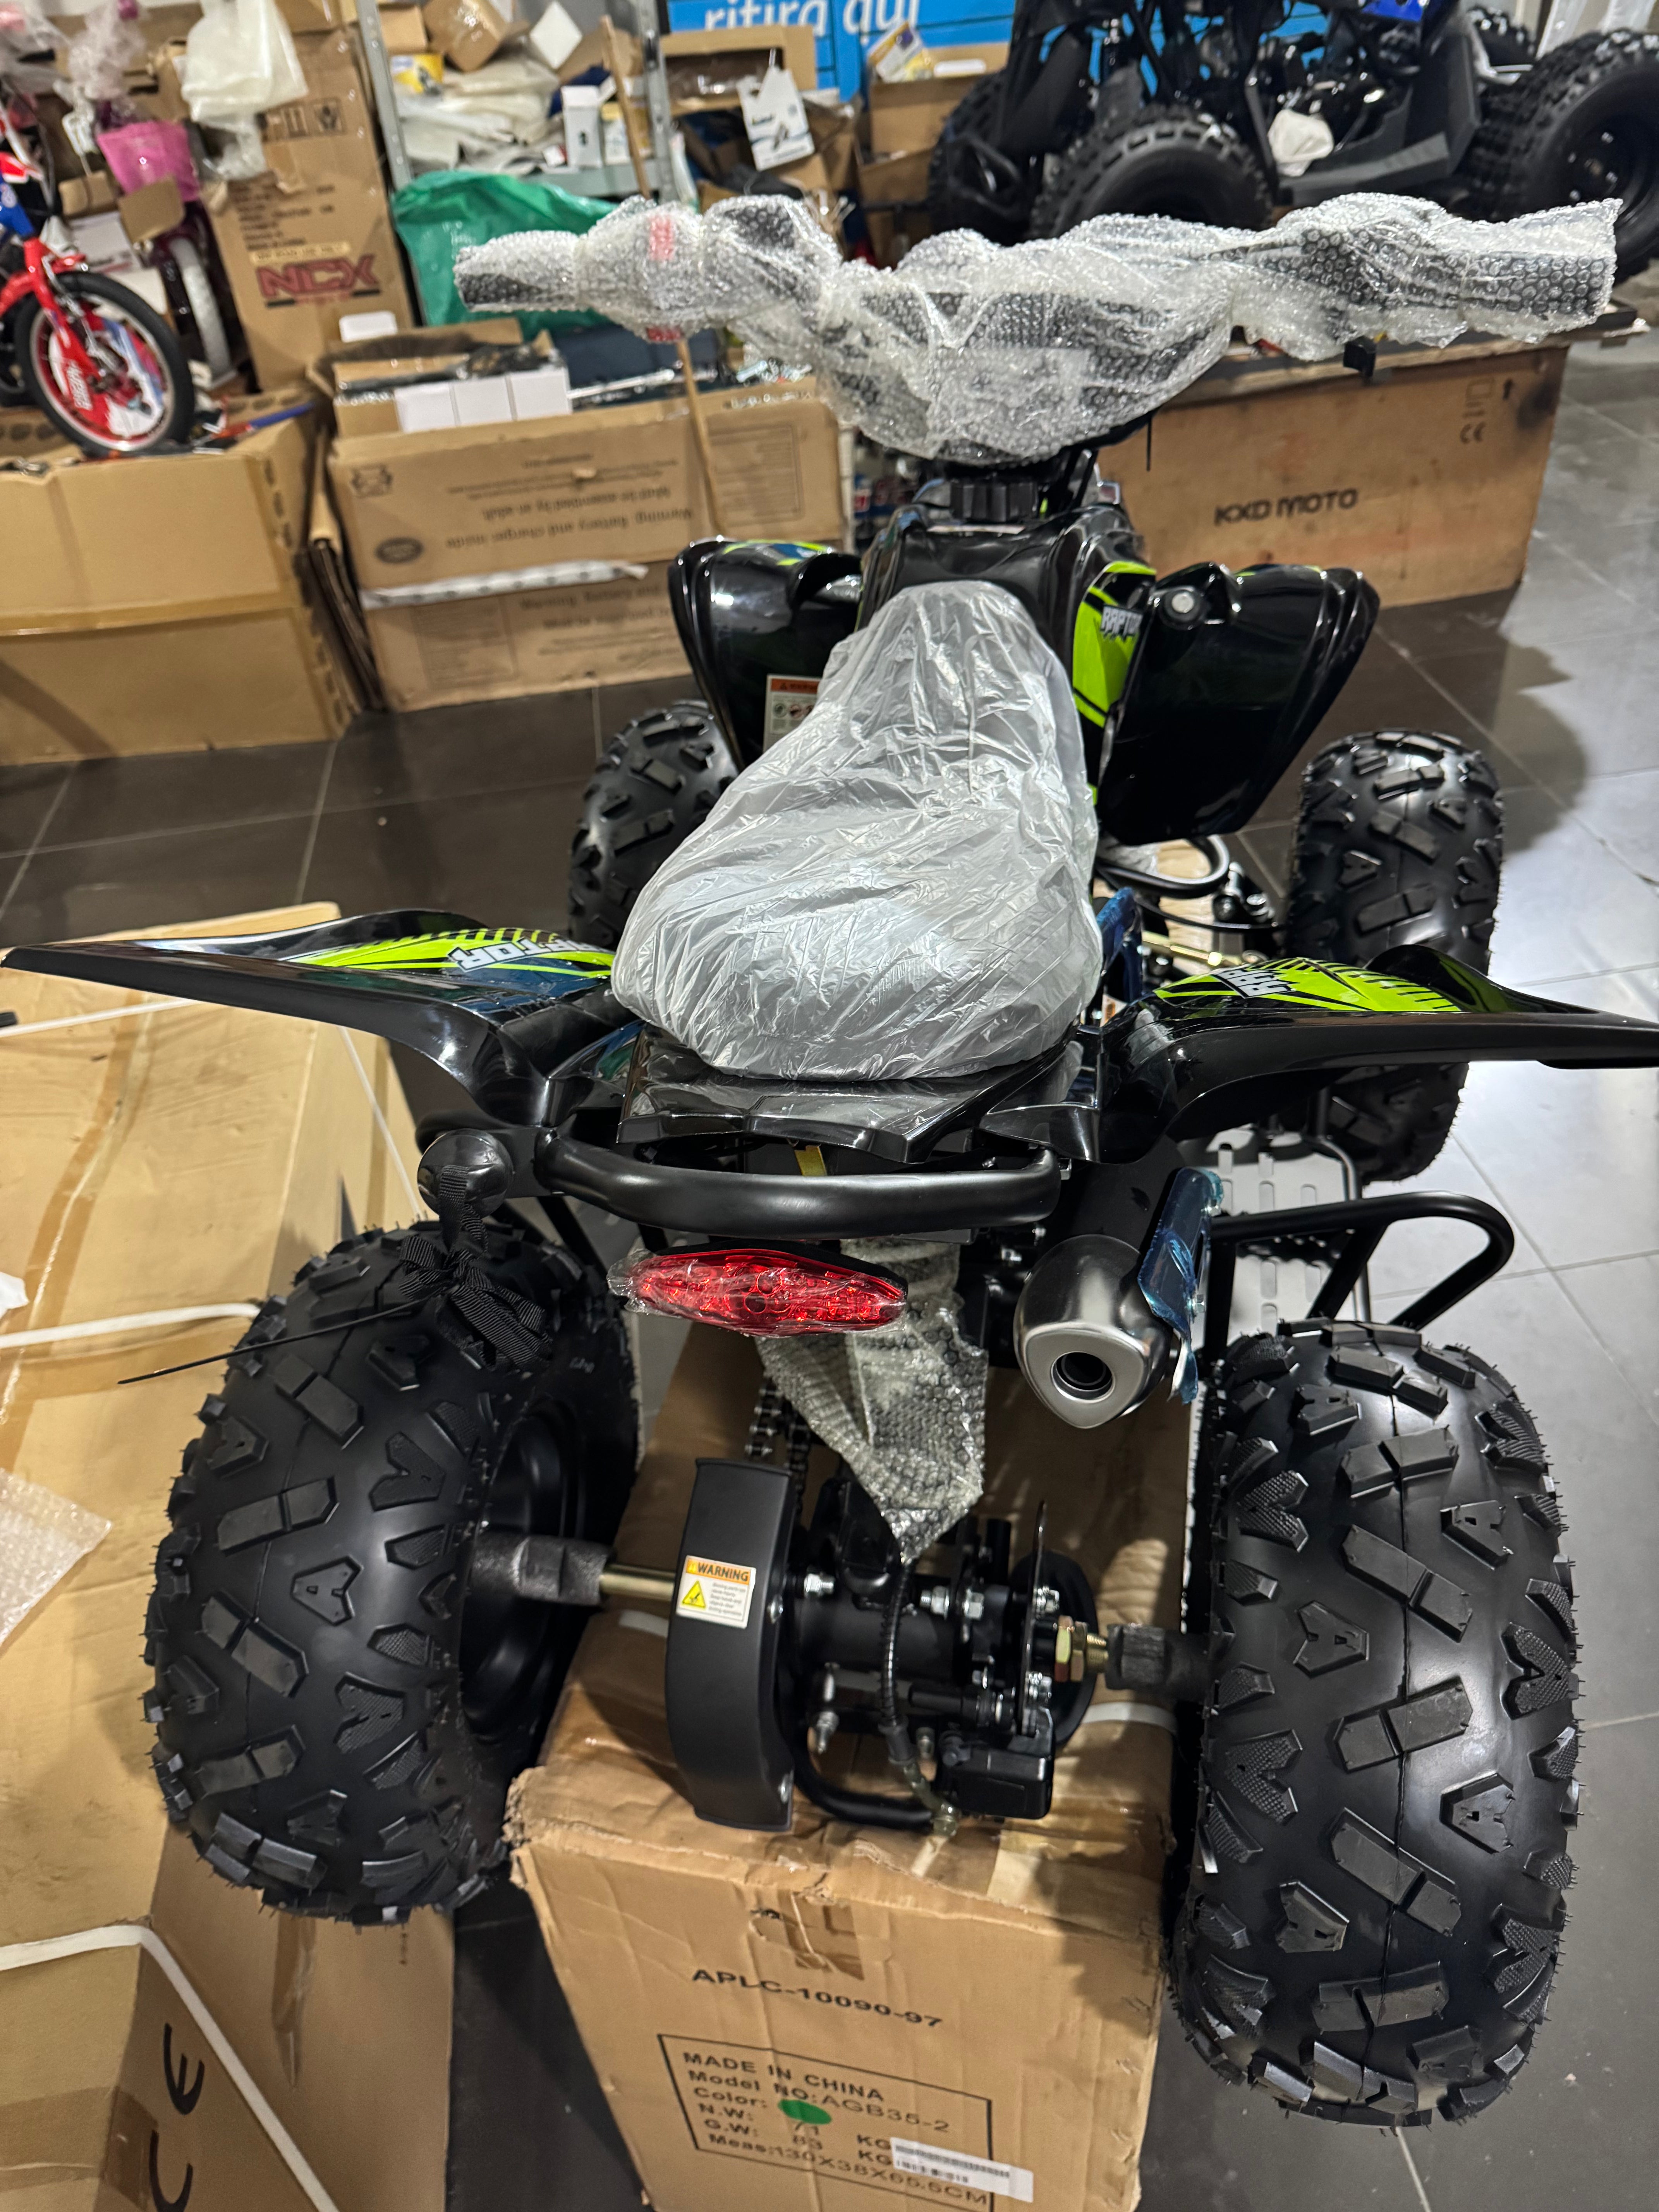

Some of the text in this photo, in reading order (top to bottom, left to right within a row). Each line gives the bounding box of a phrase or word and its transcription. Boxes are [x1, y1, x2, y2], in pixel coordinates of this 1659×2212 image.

[1214, 488, 1358, 526] KXD MOTO
[697, 1561, 750, 1582] WARNING
[692, 1969, 942, 2027] APLC-10090-97
[683, 2052, 884, 2101] MADE IN CHINA
[688, 2069, 761, 2091] Model
[694, 2087, 768, 2108] Color:
